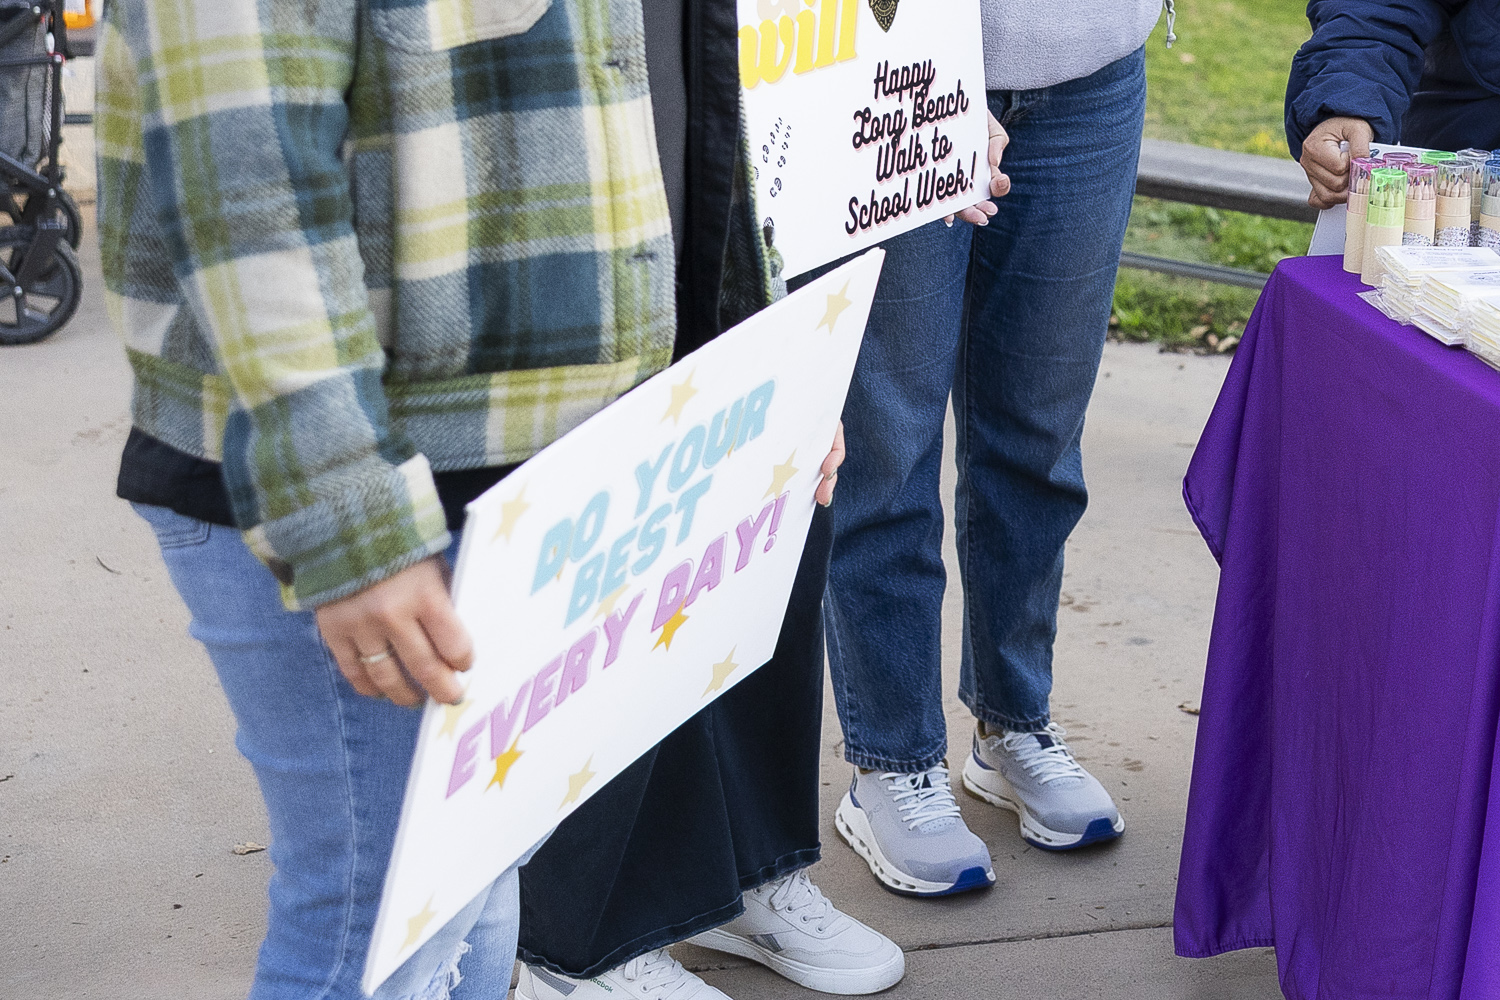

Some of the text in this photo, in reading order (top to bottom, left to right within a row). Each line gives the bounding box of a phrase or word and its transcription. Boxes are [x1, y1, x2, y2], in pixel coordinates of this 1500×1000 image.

[852, 79, 969, 150] Long Beach
[874, 59, 936, 102] Happy
[845, 151, 977, 235] School Week!
[875, 126, 952, 182] Walk to
[530, 376, 777, 597] DO YOUR
[563, 473, 714, 630] BEST
[445, 490, 790, 800] EVERY DAY!
